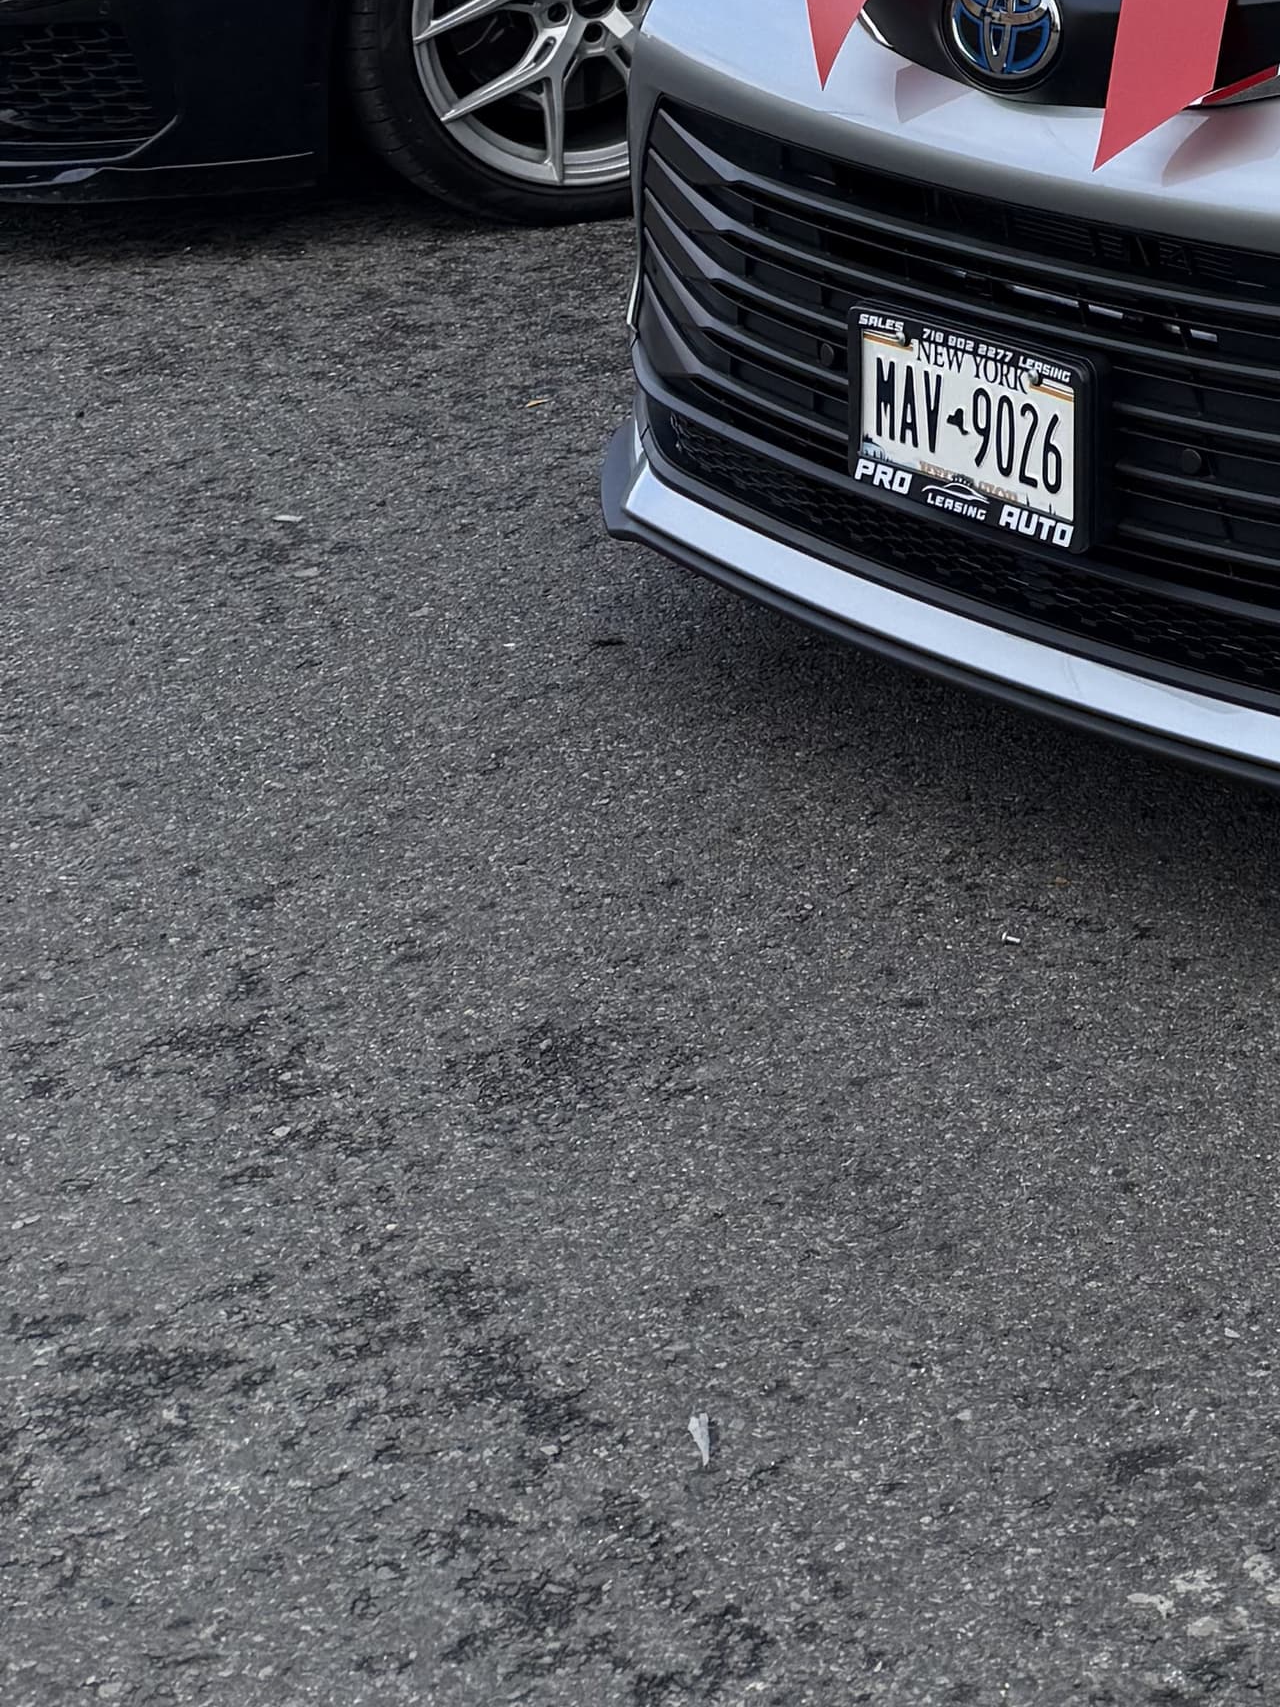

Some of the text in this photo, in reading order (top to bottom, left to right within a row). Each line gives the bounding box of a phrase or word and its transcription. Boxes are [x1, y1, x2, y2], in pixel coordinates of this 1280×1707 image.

[857, 313, 905, 332] SALES
[913, 338, 1029, 395] NEW YORK
[977, 342, 1014, 362] 2277
[1017, 354, 1072, 383] LEASING
[875, 356, 943, 454] MAV
[971, 387, 1063, 495] 9026
[853, 458, 913, 496] PRO
[926, 493, 987, 521] LEASING
[998, 503, 1075, 549] AUTO
